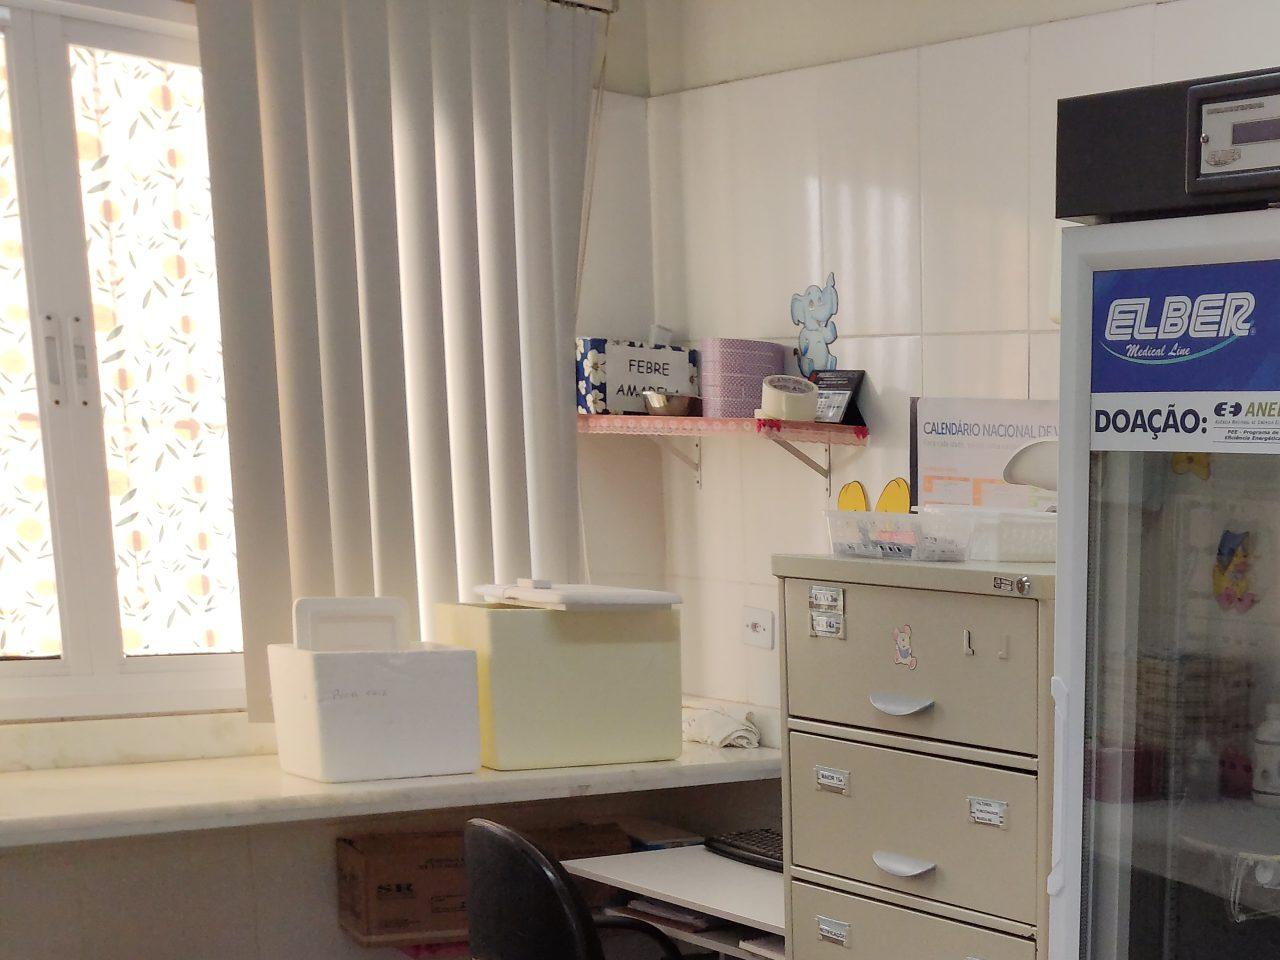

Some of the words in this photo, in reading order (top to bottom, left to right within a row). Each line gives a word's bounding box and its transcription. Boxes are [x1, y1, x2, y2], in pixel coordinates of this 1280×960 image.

[1104, 291, 1256, 341] ELBER
[1125, 342, 1165, 358] Medical
[1167, 342, 1191, 357] Line
[628, 359, 670, 377] FEBRE
[923, 419, 981, 437] CALENDÁRIO
[982, 423, 1036, 439] NACIONAL
[1094, 403, 1208, 440] DOAÇÃO:
